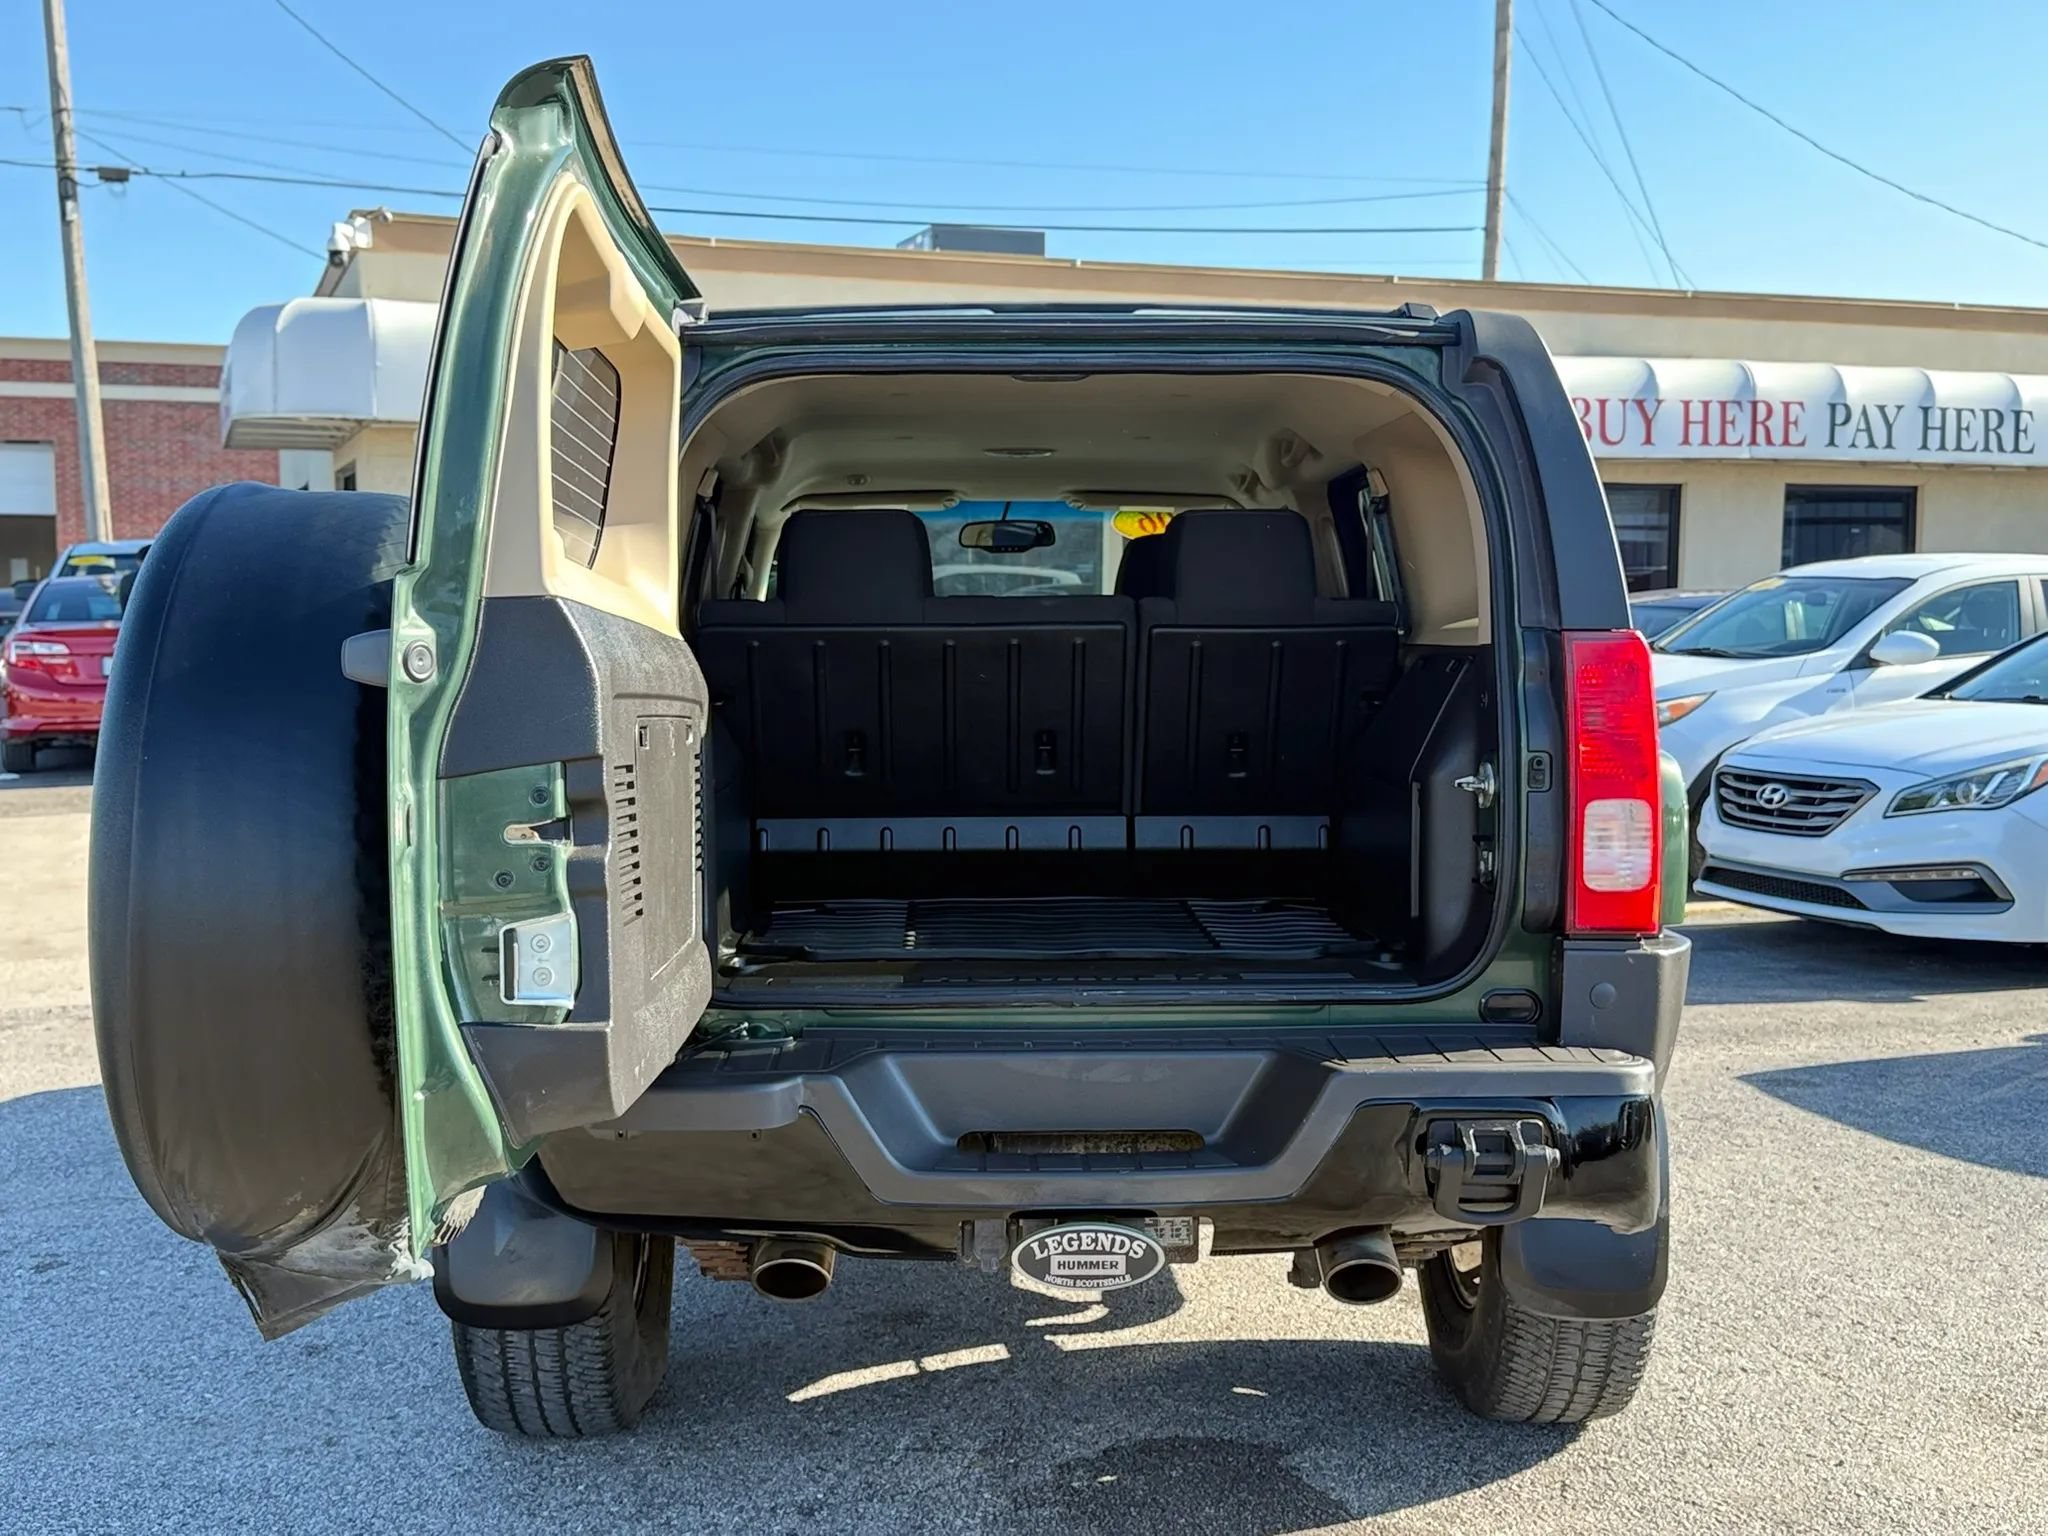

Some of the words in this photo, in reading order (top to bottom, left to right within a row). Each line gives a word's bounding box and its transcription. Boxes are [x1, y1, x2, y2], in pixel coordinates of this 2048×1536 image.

[1678, 399, 1807, 447] HERE
[1824, 402, 1905, 450] PAY
[1917, 405, 2036, 454] HERE
[1029, 1231, 1147, 1260] LEGENDS
[1056, 1260, 1119, 1270] HUMMER
[1043, 1273, 1075, 1287] NORTH
[1075, 1273, 1132, 1288] SCOTTSDALE
